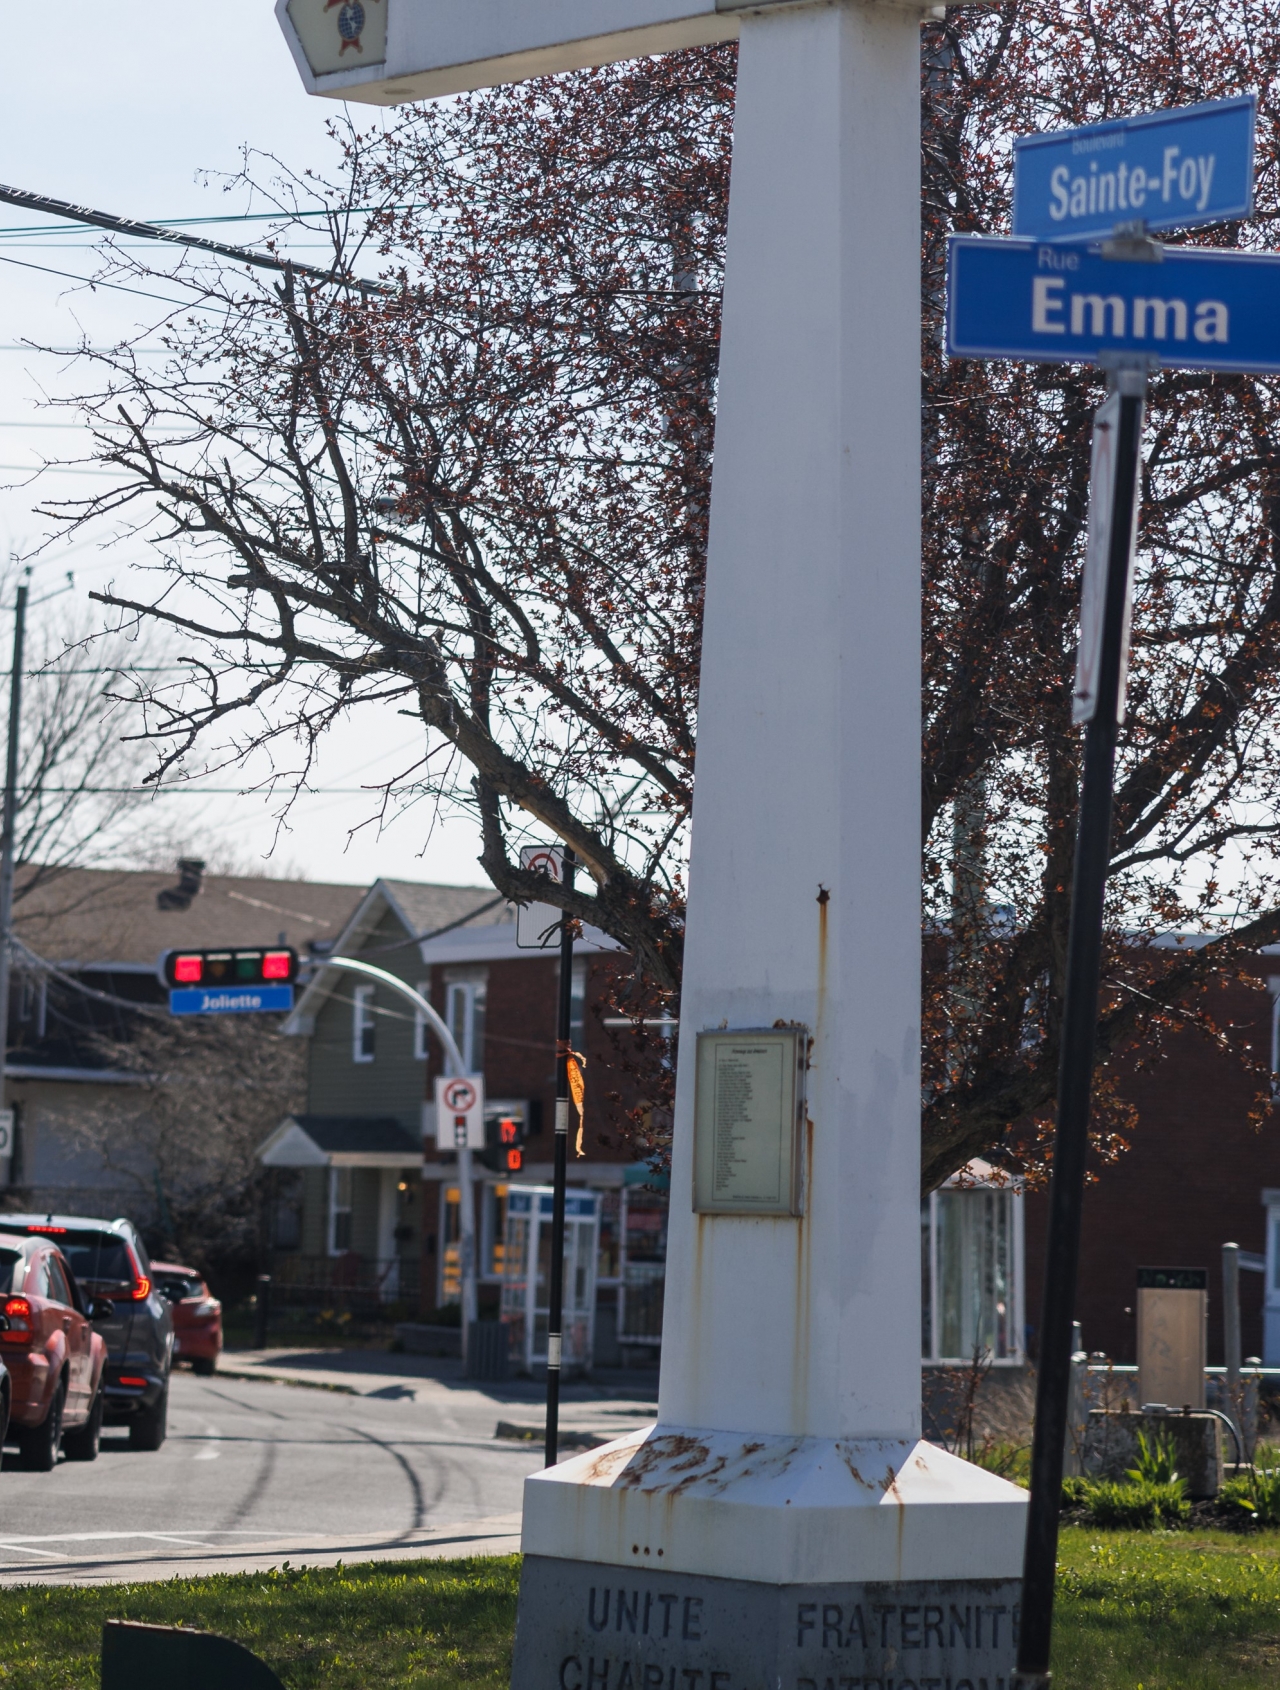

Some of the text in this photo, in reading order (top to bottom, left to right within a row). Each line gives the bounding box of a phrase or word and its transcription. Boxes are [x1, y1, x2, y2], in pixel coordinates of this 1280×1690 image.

[1048, 145, 1216, 221] Sainte-Foy
[1037, 245, 1080, 271] Rue
[1031, 275, 1230, 344] Emma
[201, 994, 262, 1010] Joliette
[588, 1586, 704, 1641] UNITE
